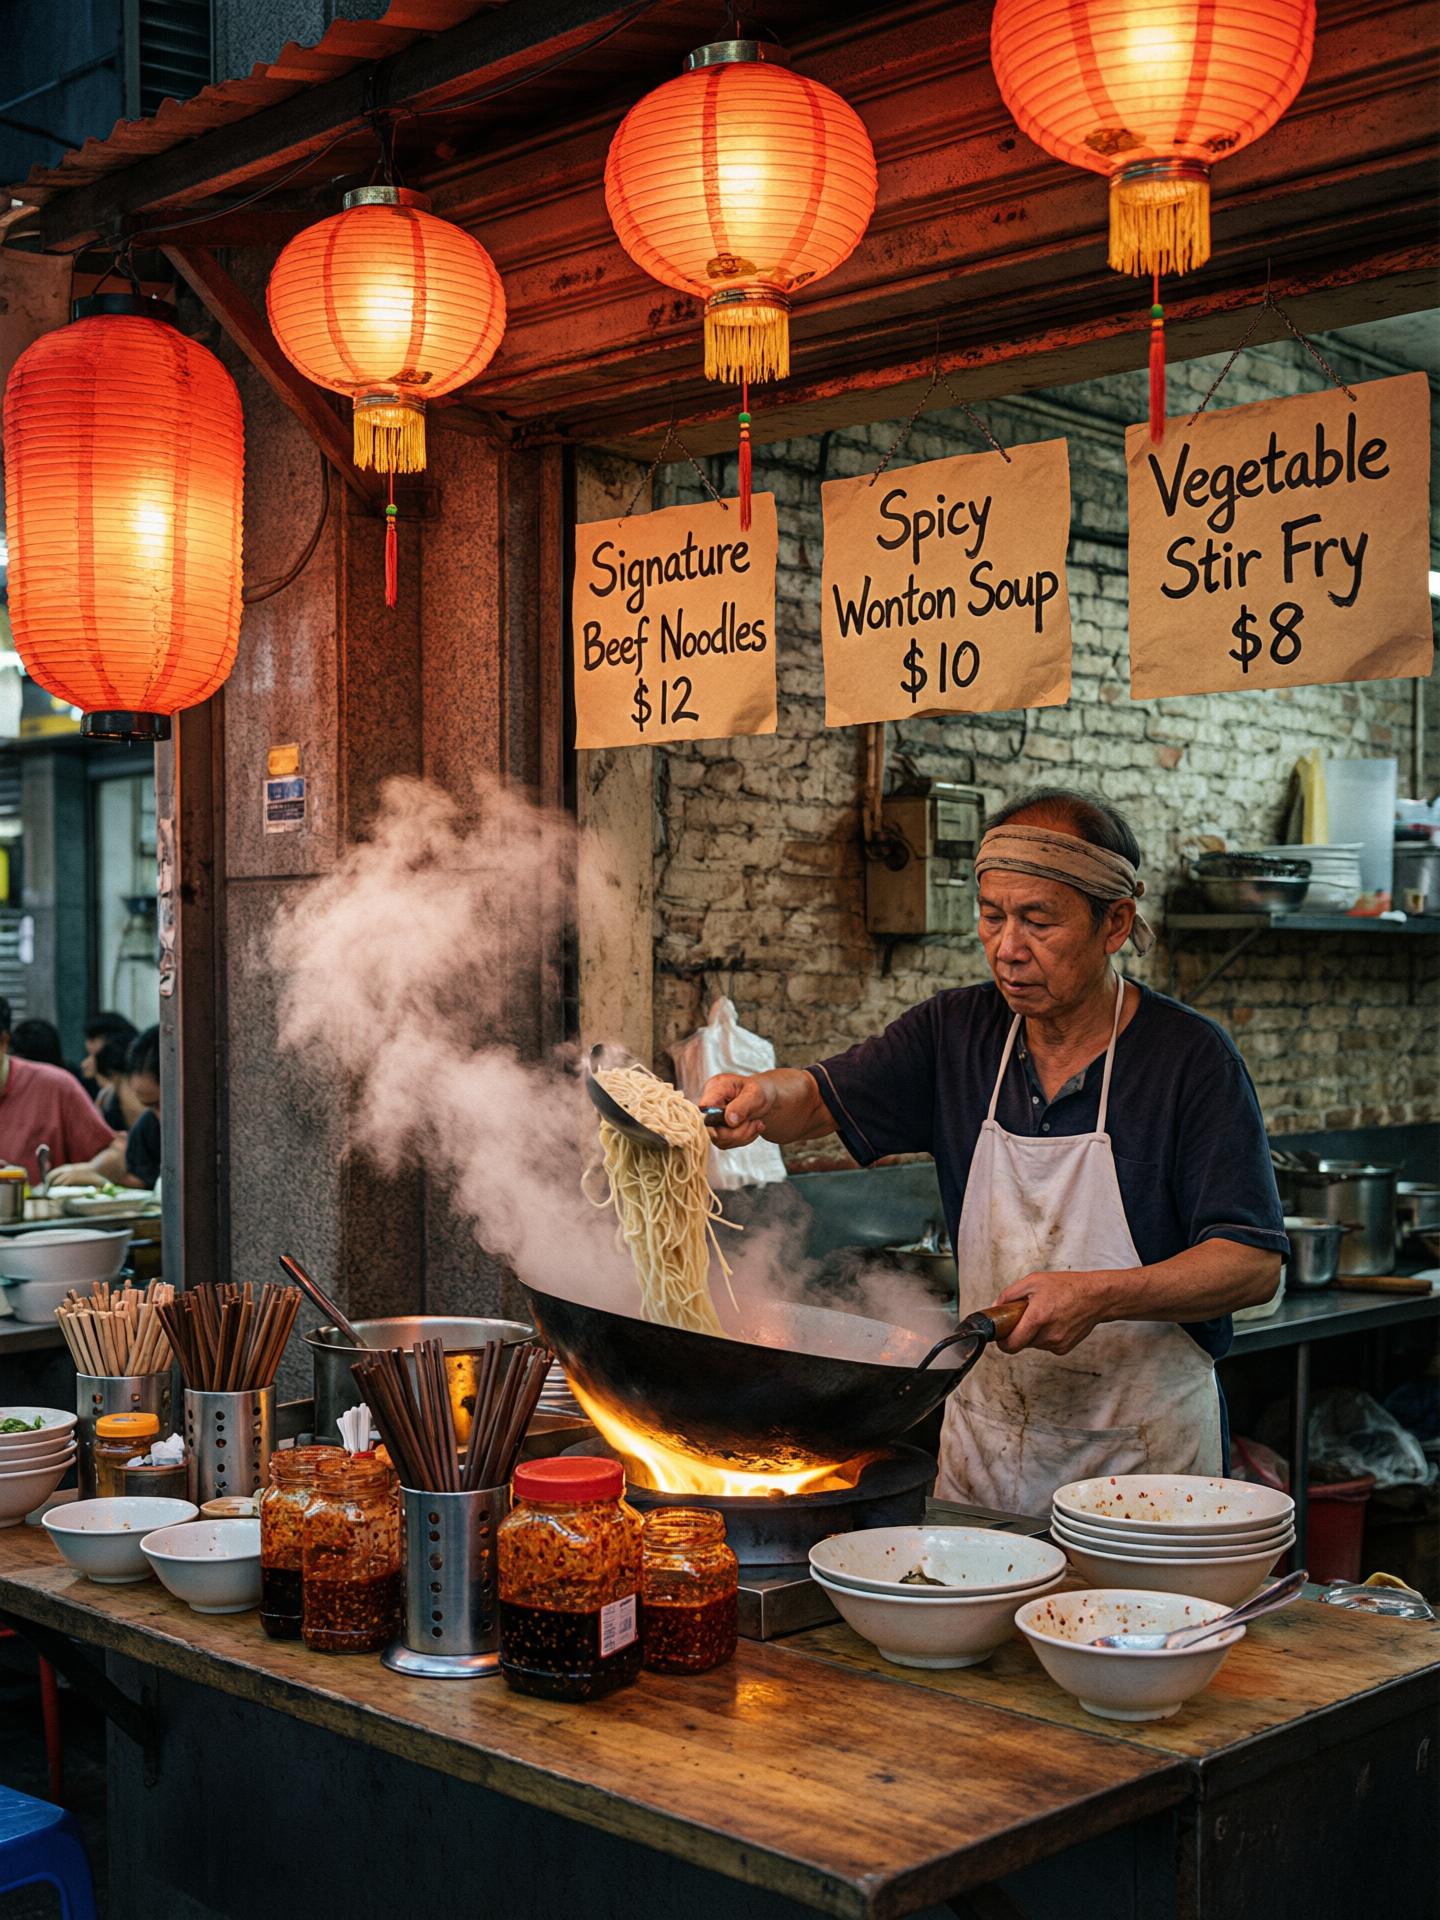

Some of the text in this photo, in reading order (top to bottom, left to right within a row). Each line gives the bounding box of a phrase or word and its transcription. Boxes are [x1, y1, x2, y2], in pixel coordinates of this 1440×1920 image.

[1149, 412, 1391, 534] Vegetable
[877, 489, 992, 565] Spicy
[1161, 513, 1369, 608] Stir Fry
[590, 530, 751, 614] Signature
[833, 561, 1059, 638] Wonton Soup
[583, 601, 767, 676] Beef Noodles
[901, 638, 980, 704] $10
[1229, 602, 1305, 674] $8
[631, 677, 700, 733] $12
